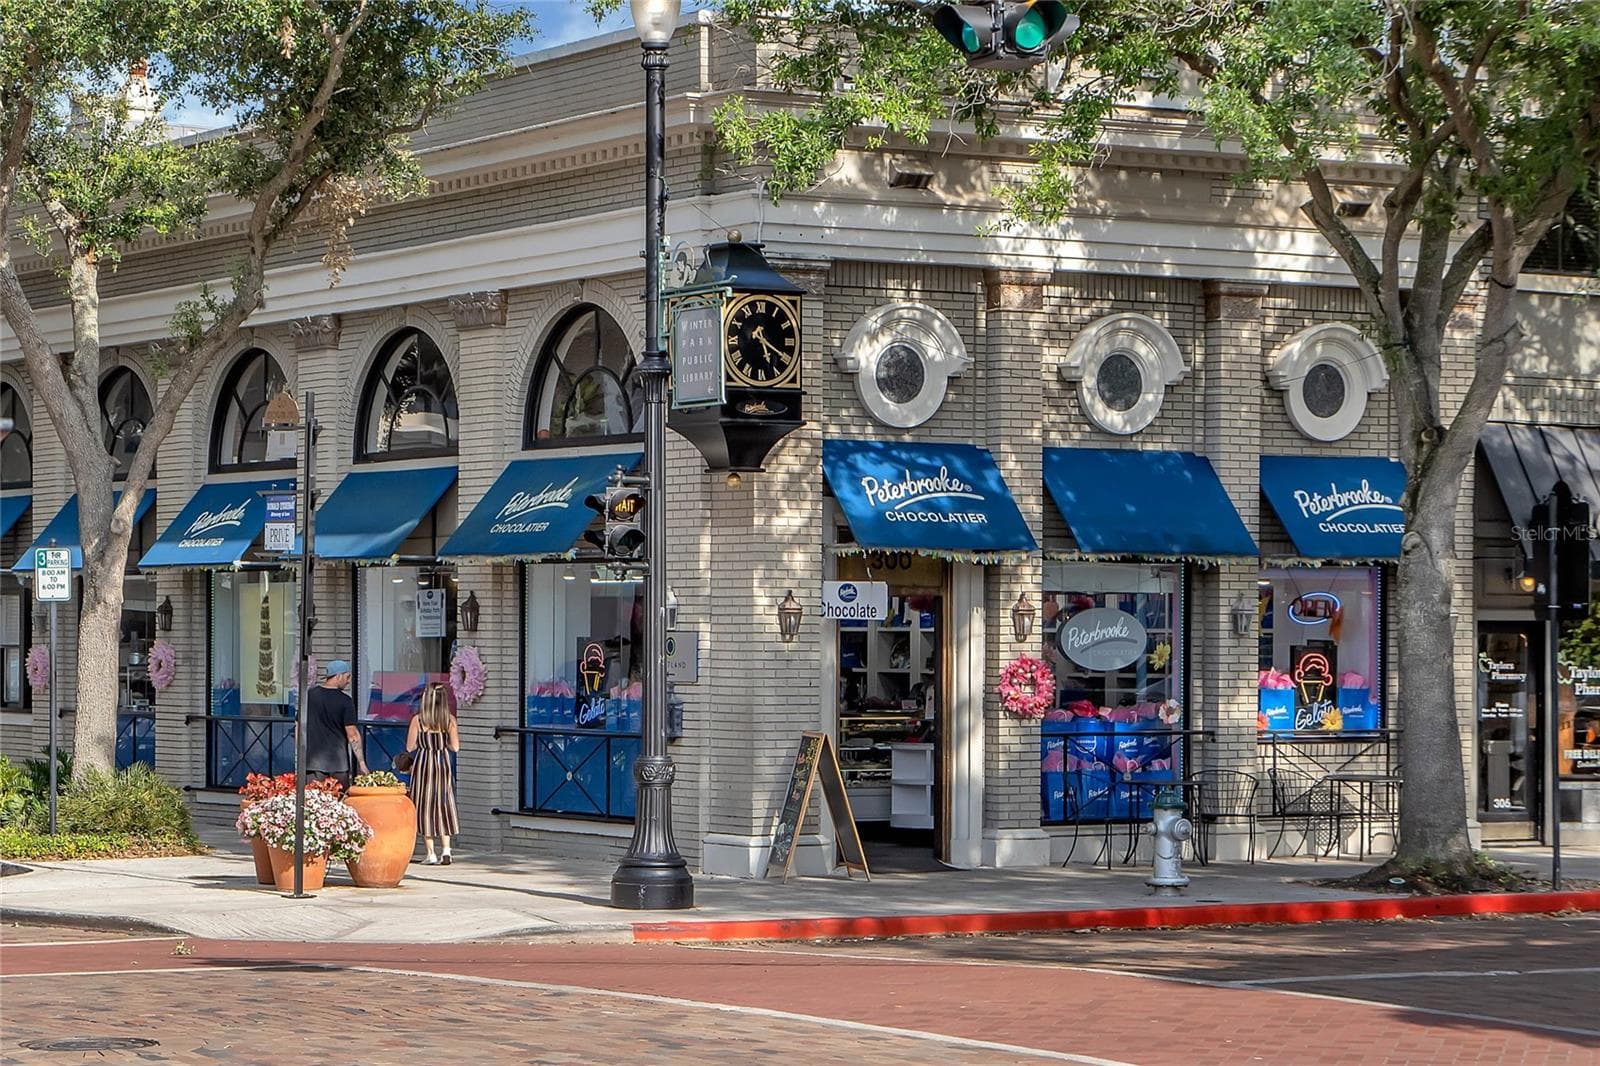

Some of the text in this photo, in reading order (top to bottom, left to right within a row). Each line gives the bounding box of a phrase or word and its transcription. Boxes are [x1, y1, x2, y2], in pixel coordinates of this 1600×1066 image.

[681, 319, 713, 334] WINTER
[682, 337, 713, 348] PARK
[682, 354, 713, 366] PUBLIC
[682, 371, 713, 383] LIBRARY
[861, 466, 964, 506] Peterbrooke
[1294, 479, 1385, 518] Peterbrooke
[885, 511, 988, 523] CHOCOLATIER
[269, 528, 290, 543] PRIVE
[490, 522, 550, 534] CHOCOLATIER
[38, 551, 46, 566] 3
[1068, 617, 1130, 650] Peterbrooke
[580, 697, 605, 725] Gelato
